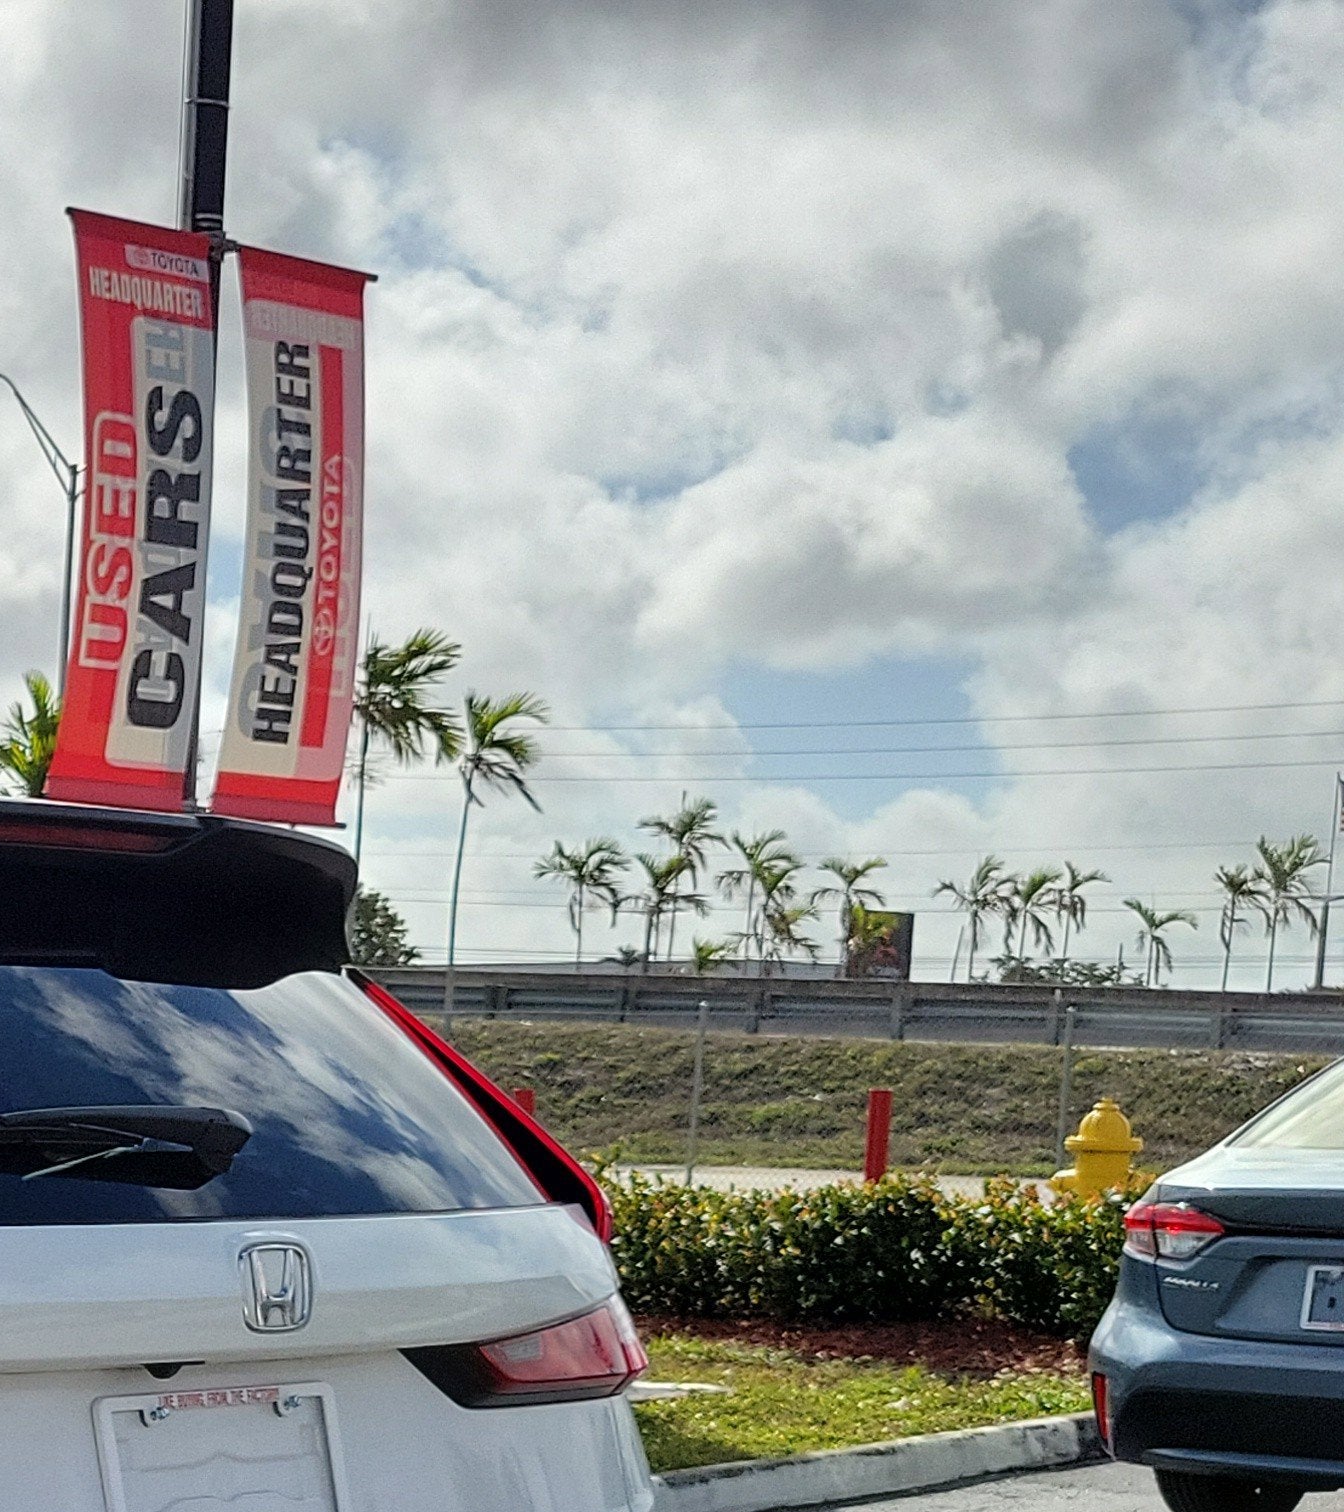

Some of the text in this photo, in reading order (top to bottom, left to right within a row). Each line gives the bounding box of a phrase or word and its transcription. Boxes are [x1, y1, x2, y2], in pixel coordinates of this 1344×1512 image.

[89, 265, 203, 319] HEADQUARTER
[150, 252, 200, 277] TOYOTA
[79, 410, 137, 668] USED
[126, 385, 204, 729] CARS
[252, 341, 314, 744] HEADQUARTER
[319, 454, 343, 603] TOYOTA
